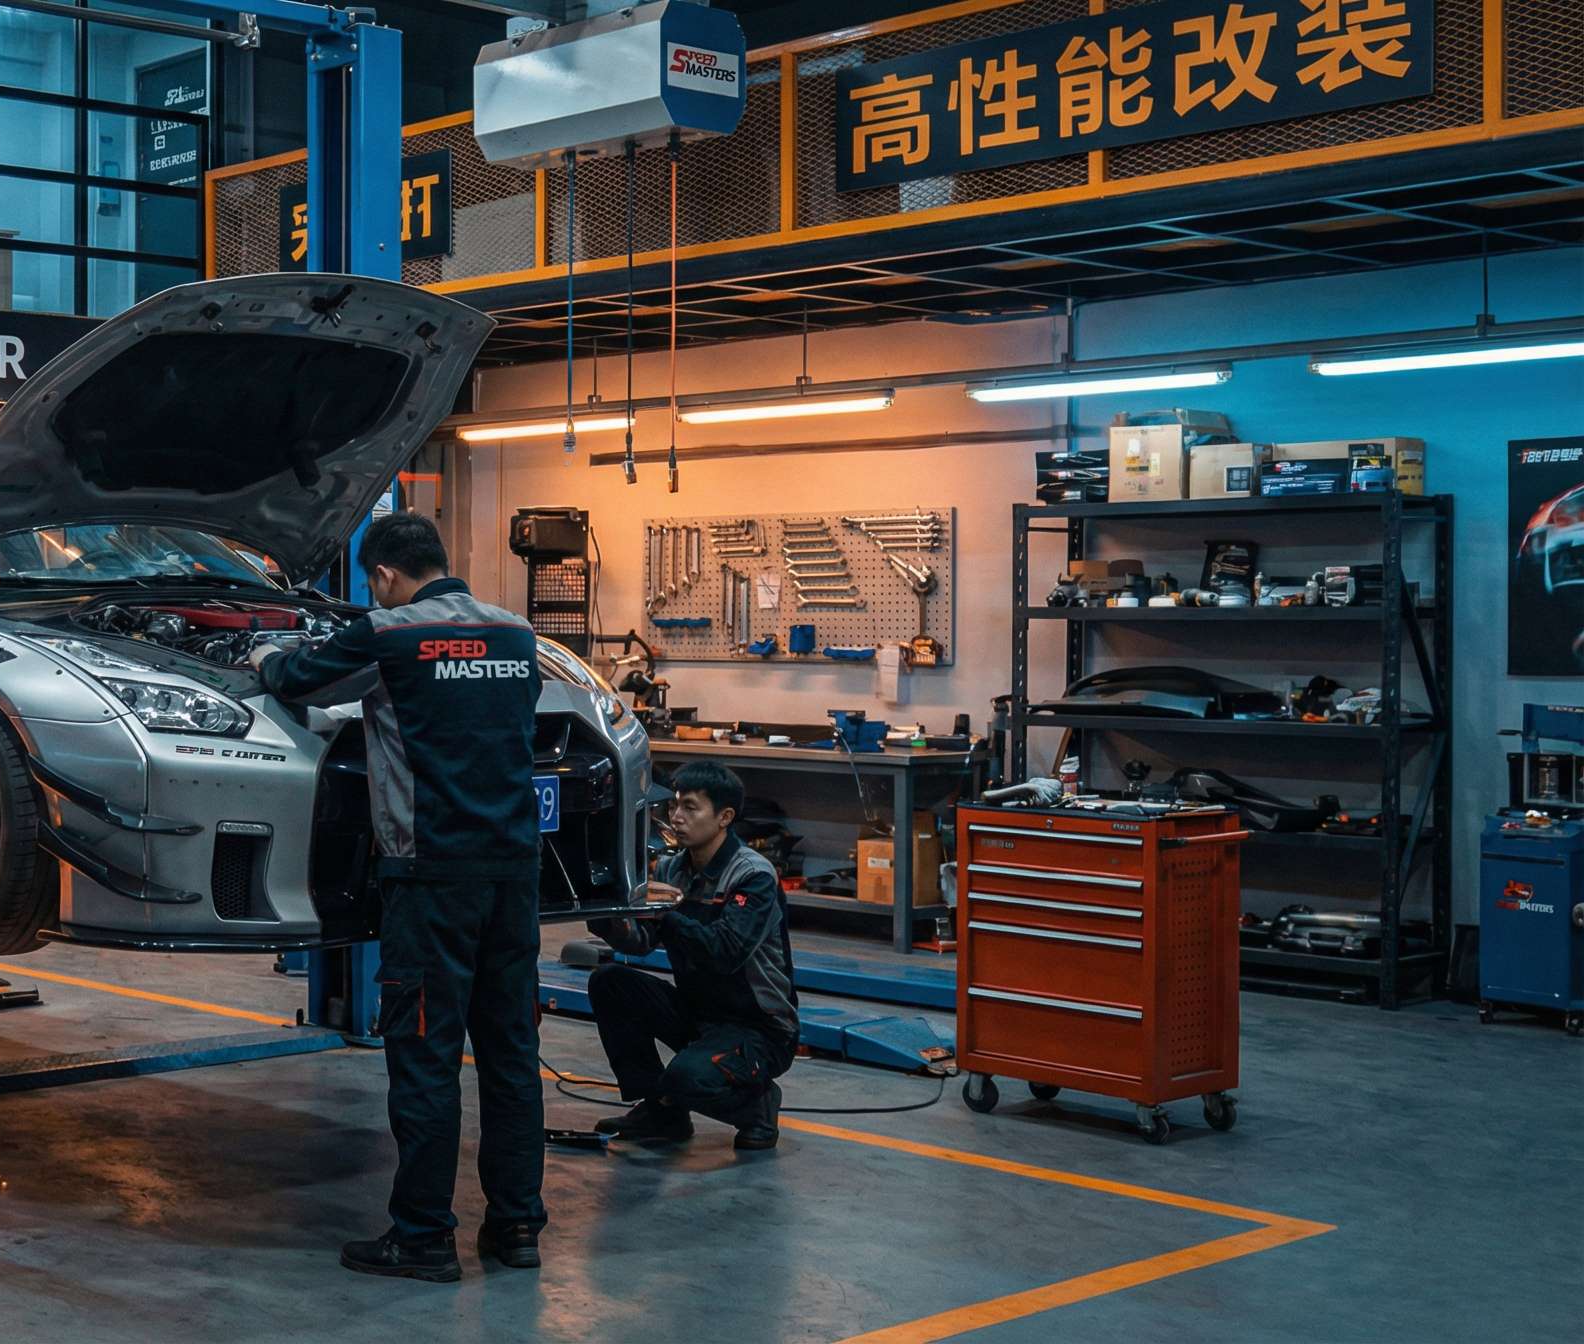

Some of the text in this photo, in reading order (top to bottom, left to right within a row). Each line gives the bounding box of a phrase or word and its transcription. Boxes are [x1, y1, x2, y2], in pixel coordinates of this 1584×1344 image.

[685, 60, 736, 82] MASTERS
[849, 0, 1413, 174] 高性能改装
[417, 640, 487, 660] SPEED
[434, 660, 530, 679] MASTERS
